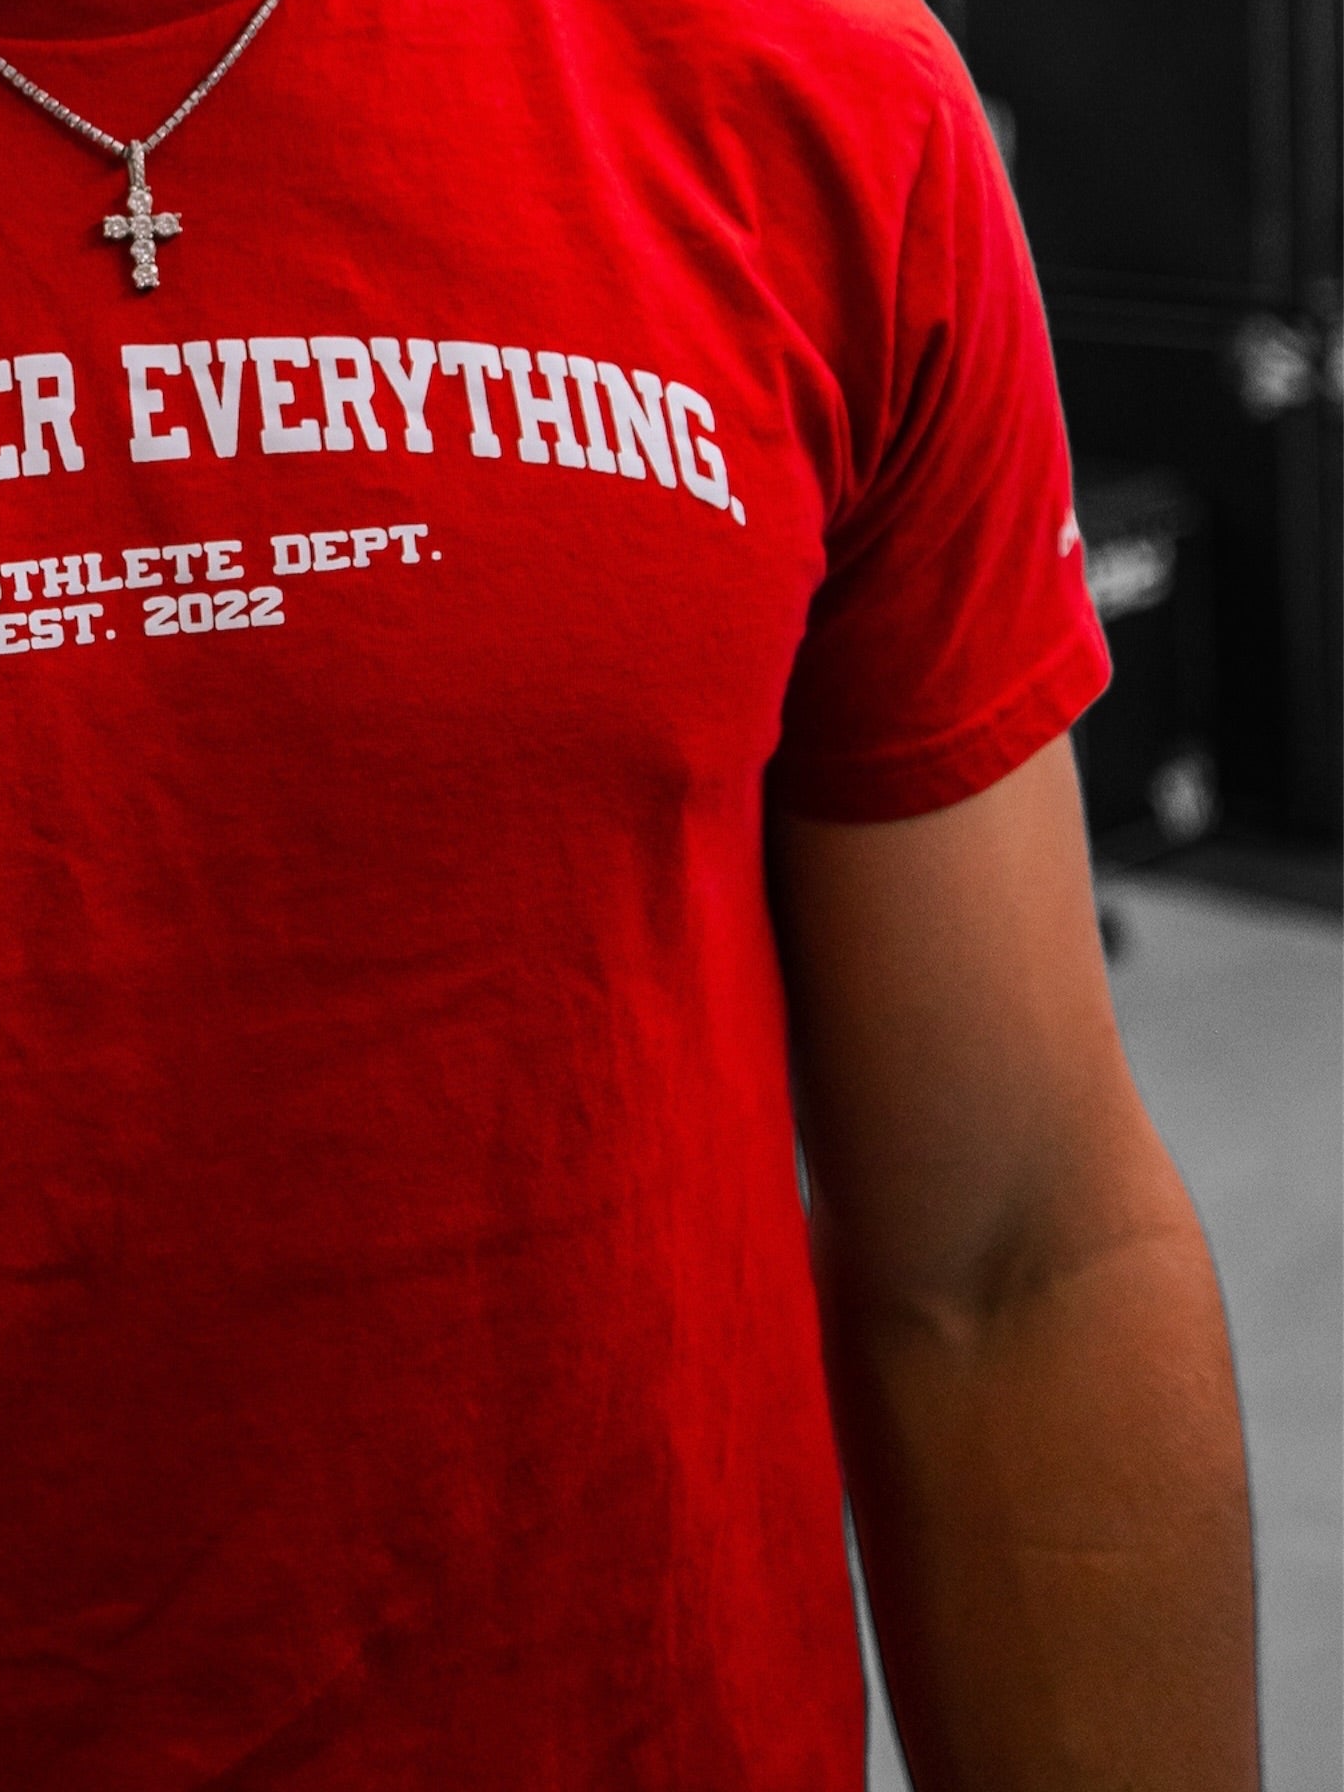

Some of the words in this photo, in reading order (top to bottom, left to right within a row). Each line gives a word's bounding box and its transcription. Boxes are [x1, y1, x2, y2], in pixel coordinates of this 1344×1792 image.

[120, 335, 747, 527] EVERYTHING.
[270, 523, 443, 576] DEPT.
[142, 585, 285, 637] 2022
